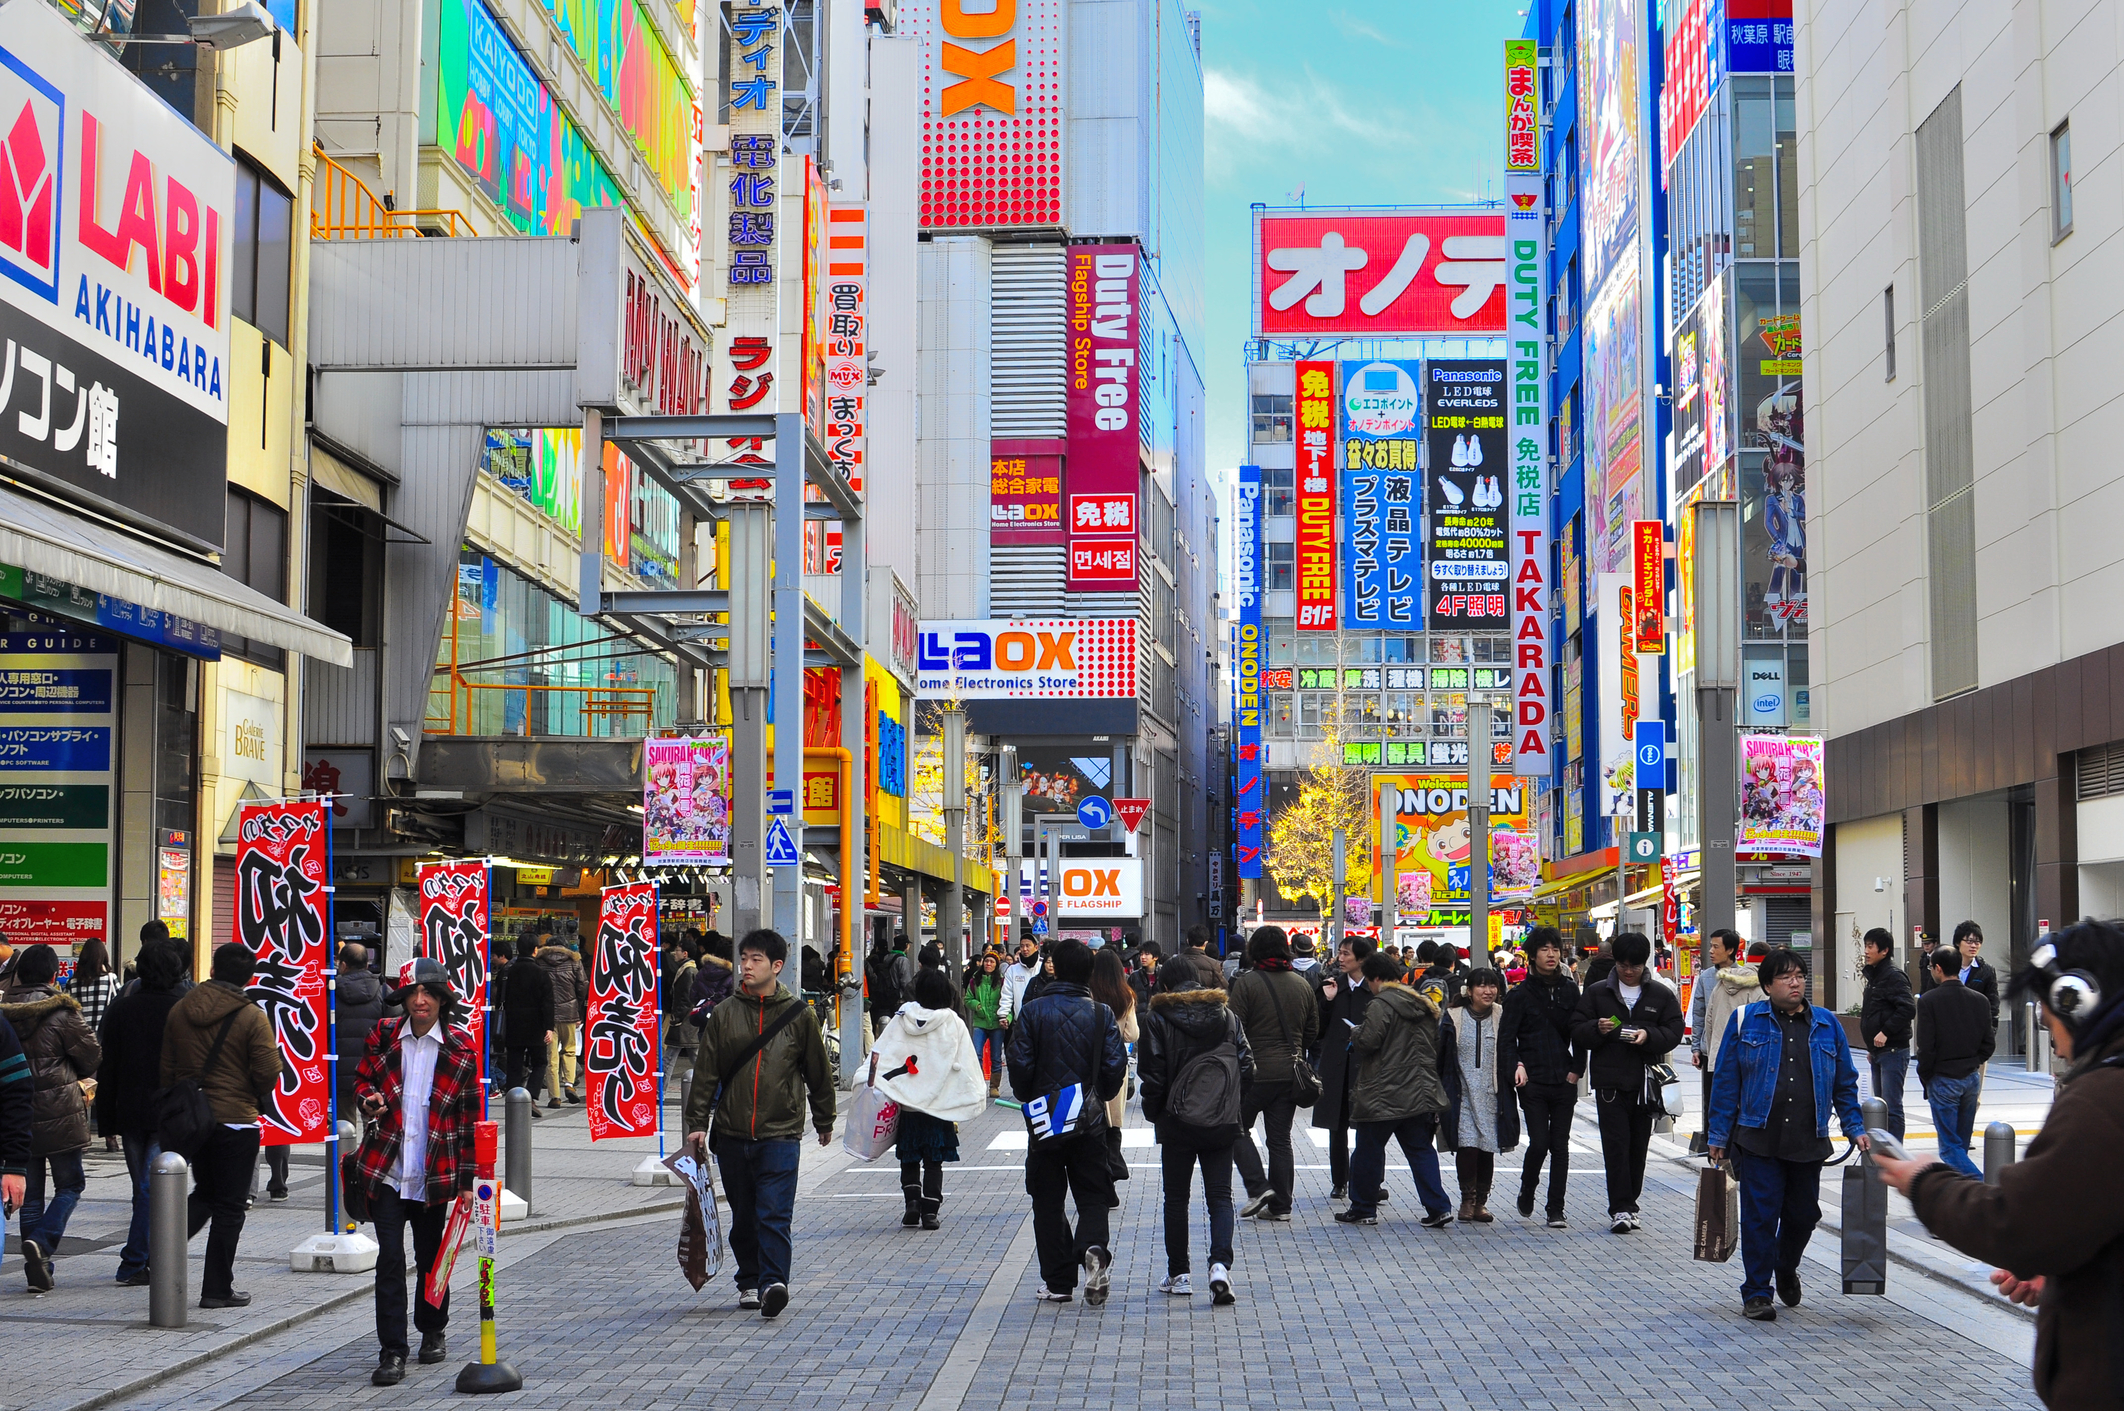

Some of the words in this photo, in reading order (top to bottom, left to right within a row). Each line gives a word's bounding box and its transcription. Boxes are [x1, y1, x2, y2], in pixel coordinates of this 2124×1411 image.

[731, 0, 778, 110] ディオ
[1731, 24, 1768, 45] 秋葉原
[474, 16, 536, 118] KAIYODO
[469, 60, 491, 103] HOBBY
[494, 94, 514, 131] LOBBY
[518, 122, 537, 161] TOKYO
[1509, 66, 1535, 166] まんが喫茶
[78, 108, 222, 333] LABI
[729, 134, 776, 286] 電化製品
[1071, 254, 1092, 331] Flagship
[1091, 253, 1134, 340] Duty
[1514, 239, 1538, 330] DUTY
[73, 273, 223, 401] AKIHABARA
[830, 282, 861, 357] 買取り
[1074, 337, 1092, 390] Store
[1432, 368, 1503, 382] Panasonic
[1516, 340, 1540, 426] FREE
[1094, 348, 1134, 431] Free
[1301, 369, 1330, 428] 免税
[1363, 398, 1413, 410] エコポイント
[1437, 398, 1499, 407] EVERLEDS
[1443, 386, 1492, 397] LED電球
[1348, 418, 1415, 432] オノデンポイント
[991, 458, 1026, 477] 本店
[1346, 438, 1418, 471] 益々お買得
[1515, 437, 1541, 517] 免税店
[991, 476, 1060, 495] 総合家電
[1010, 520, 1043, 528] Electronics
[1075, 501, 1130, 527] 免税
[1302, 498, 1330, 549] DUTY
[1074, 550, 1131, 570] 면세점
[1239, 481, 1260, 608] Panasonic
[1352, 474, 1380, 621] プラズマテレビ
[1384, 476, 1413, 622] 液晶テレビ
[1302, 552, 1331, 600] FREE
[1433, 563, 1507, 577] 今すぐ取り替えましょう!
[1643, 534, 1654, 607] カードキングダム
[1299, 605, 1333, 625] B1F
[1435, 594, 1506, 617] 4F照明
[27, 637, 96, 649] GUIDE
[1515, 529, 1546, 755] TAKARADA
[1619, 584, 1640, 742] GAMERS
[919, 678, 950, 689] ome
[955, 676, 1033, 689] Electronics
[1038, 675, 1077, 689] Store
[1240, 623, 1260, 727] ONODEN
[1752, 672, 1781, 680] DELL
[1756, 697, 1777, 708] intel
[235, 724, 265, 761] BRAVE
[1239, 742, 1260, 864] オノデン
[1417, 779, 1469, 789] Welcome
[1120, 806, 1144, 814] 止まれ
[1647, 790, 1655, 833] ALIENWA
[1067, 900, 1123, 909] FLAGSHIP
